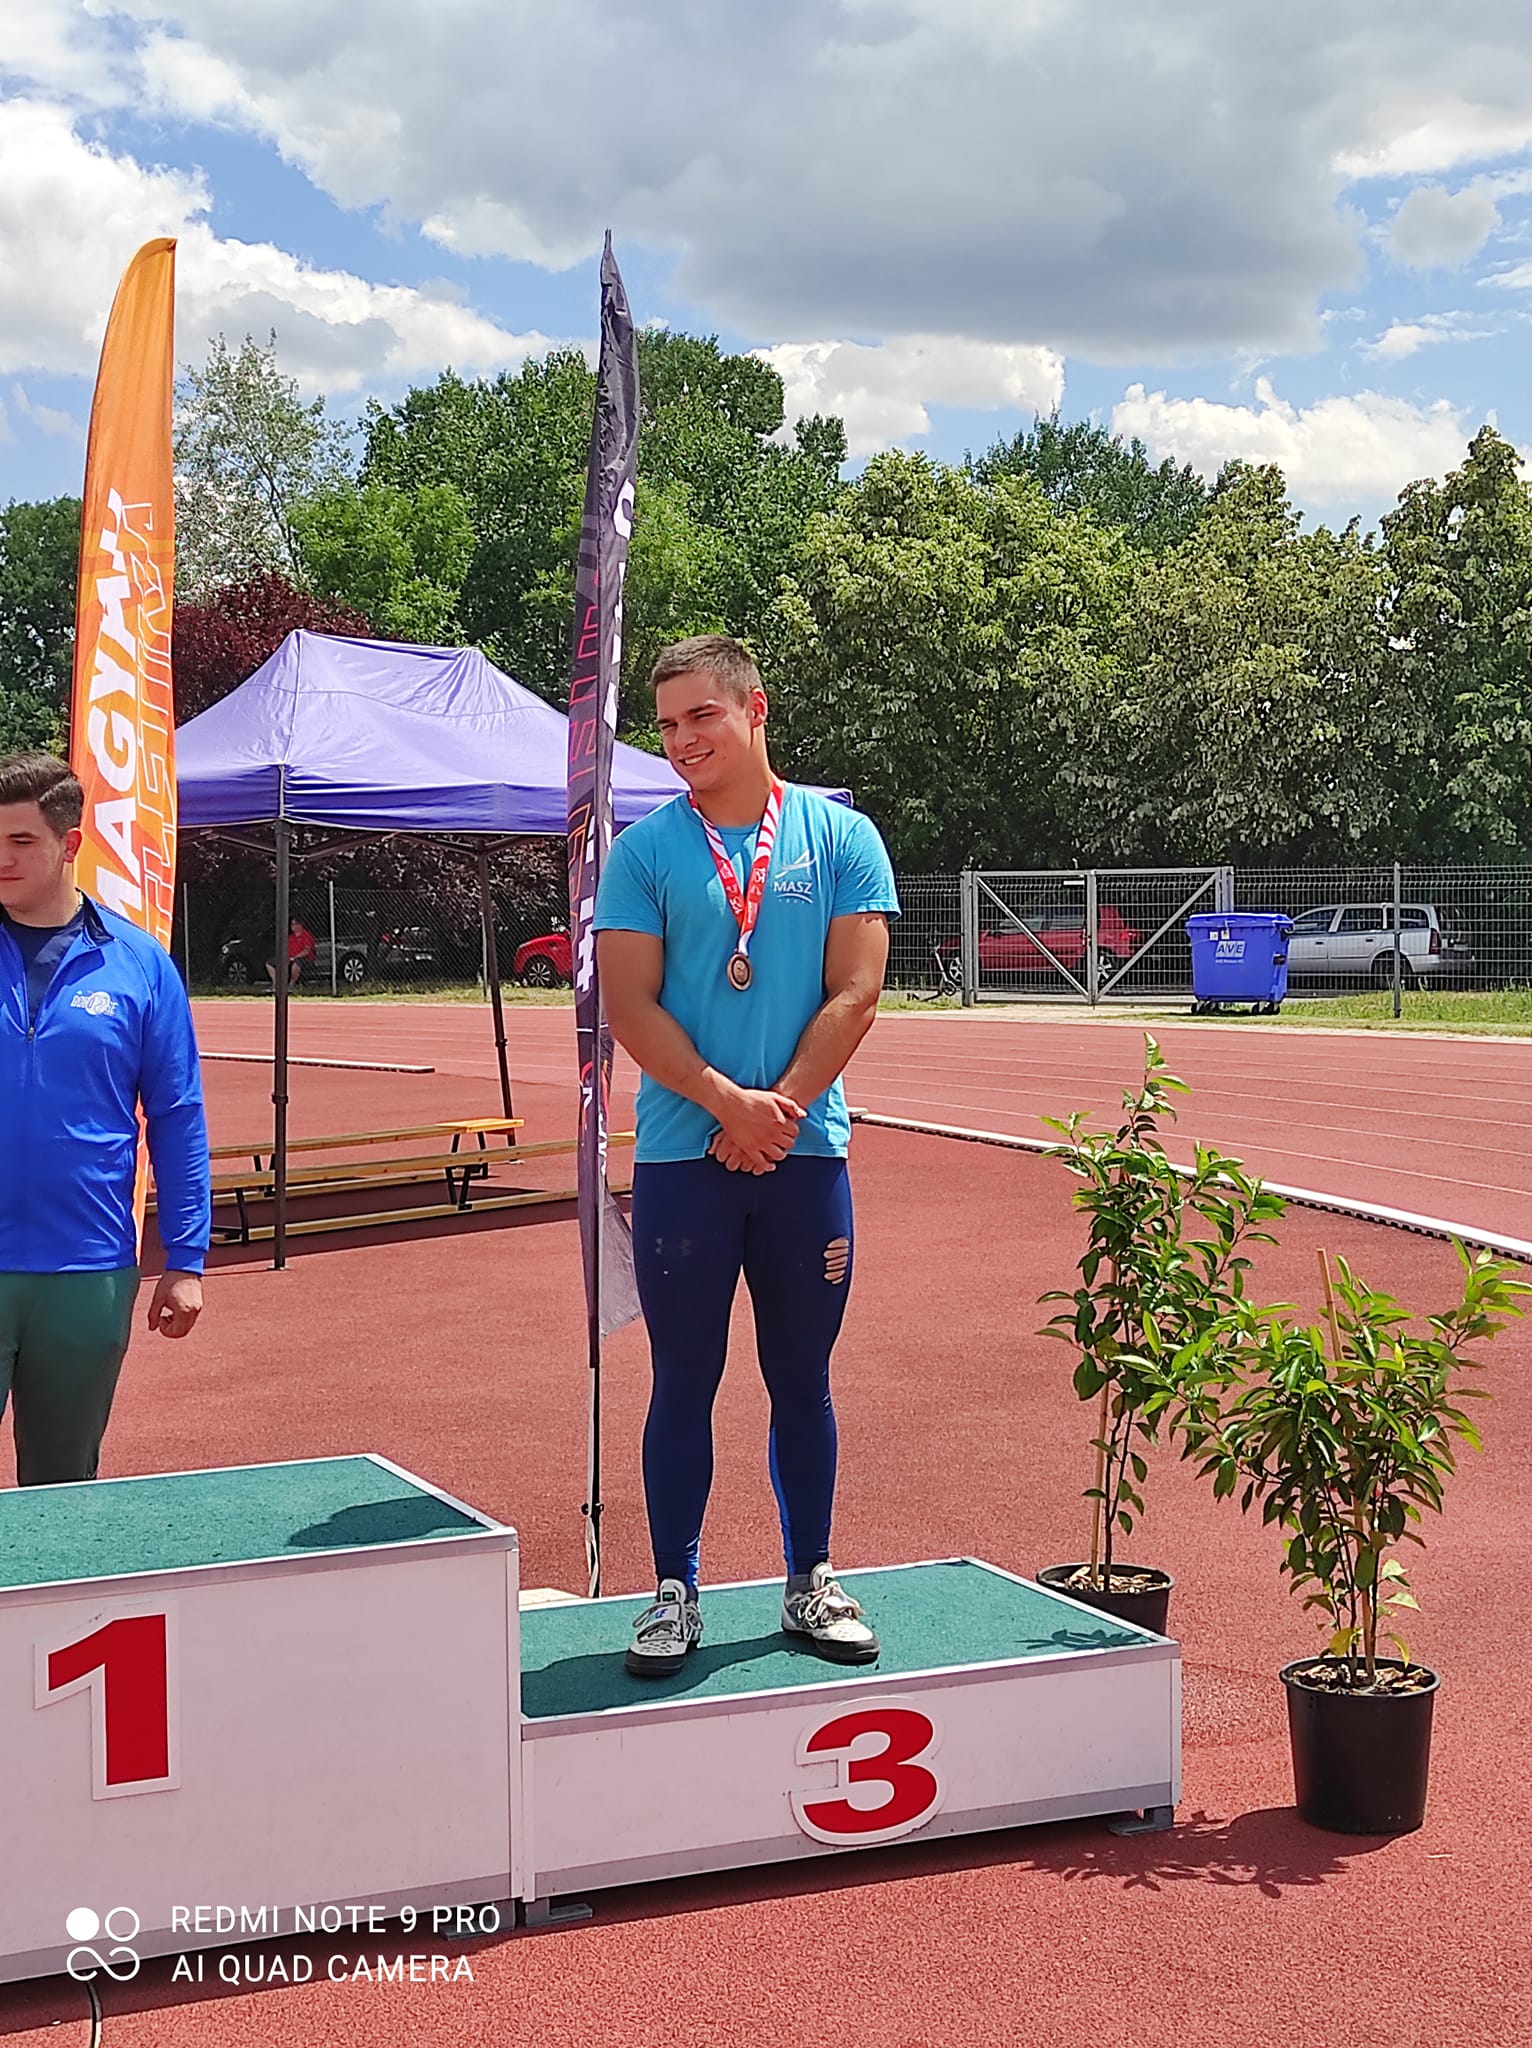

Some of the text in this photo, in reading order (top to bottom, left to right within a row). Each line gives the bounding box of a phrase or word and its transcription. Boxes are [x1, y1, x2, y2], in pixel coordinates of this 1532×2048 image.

[773, 880, 813, 894] MASZ
[1217, 943, 1244, 954] AVE
[49, 1615, 168, 1784] 1
[804, 1709, 938, 1834] 3
